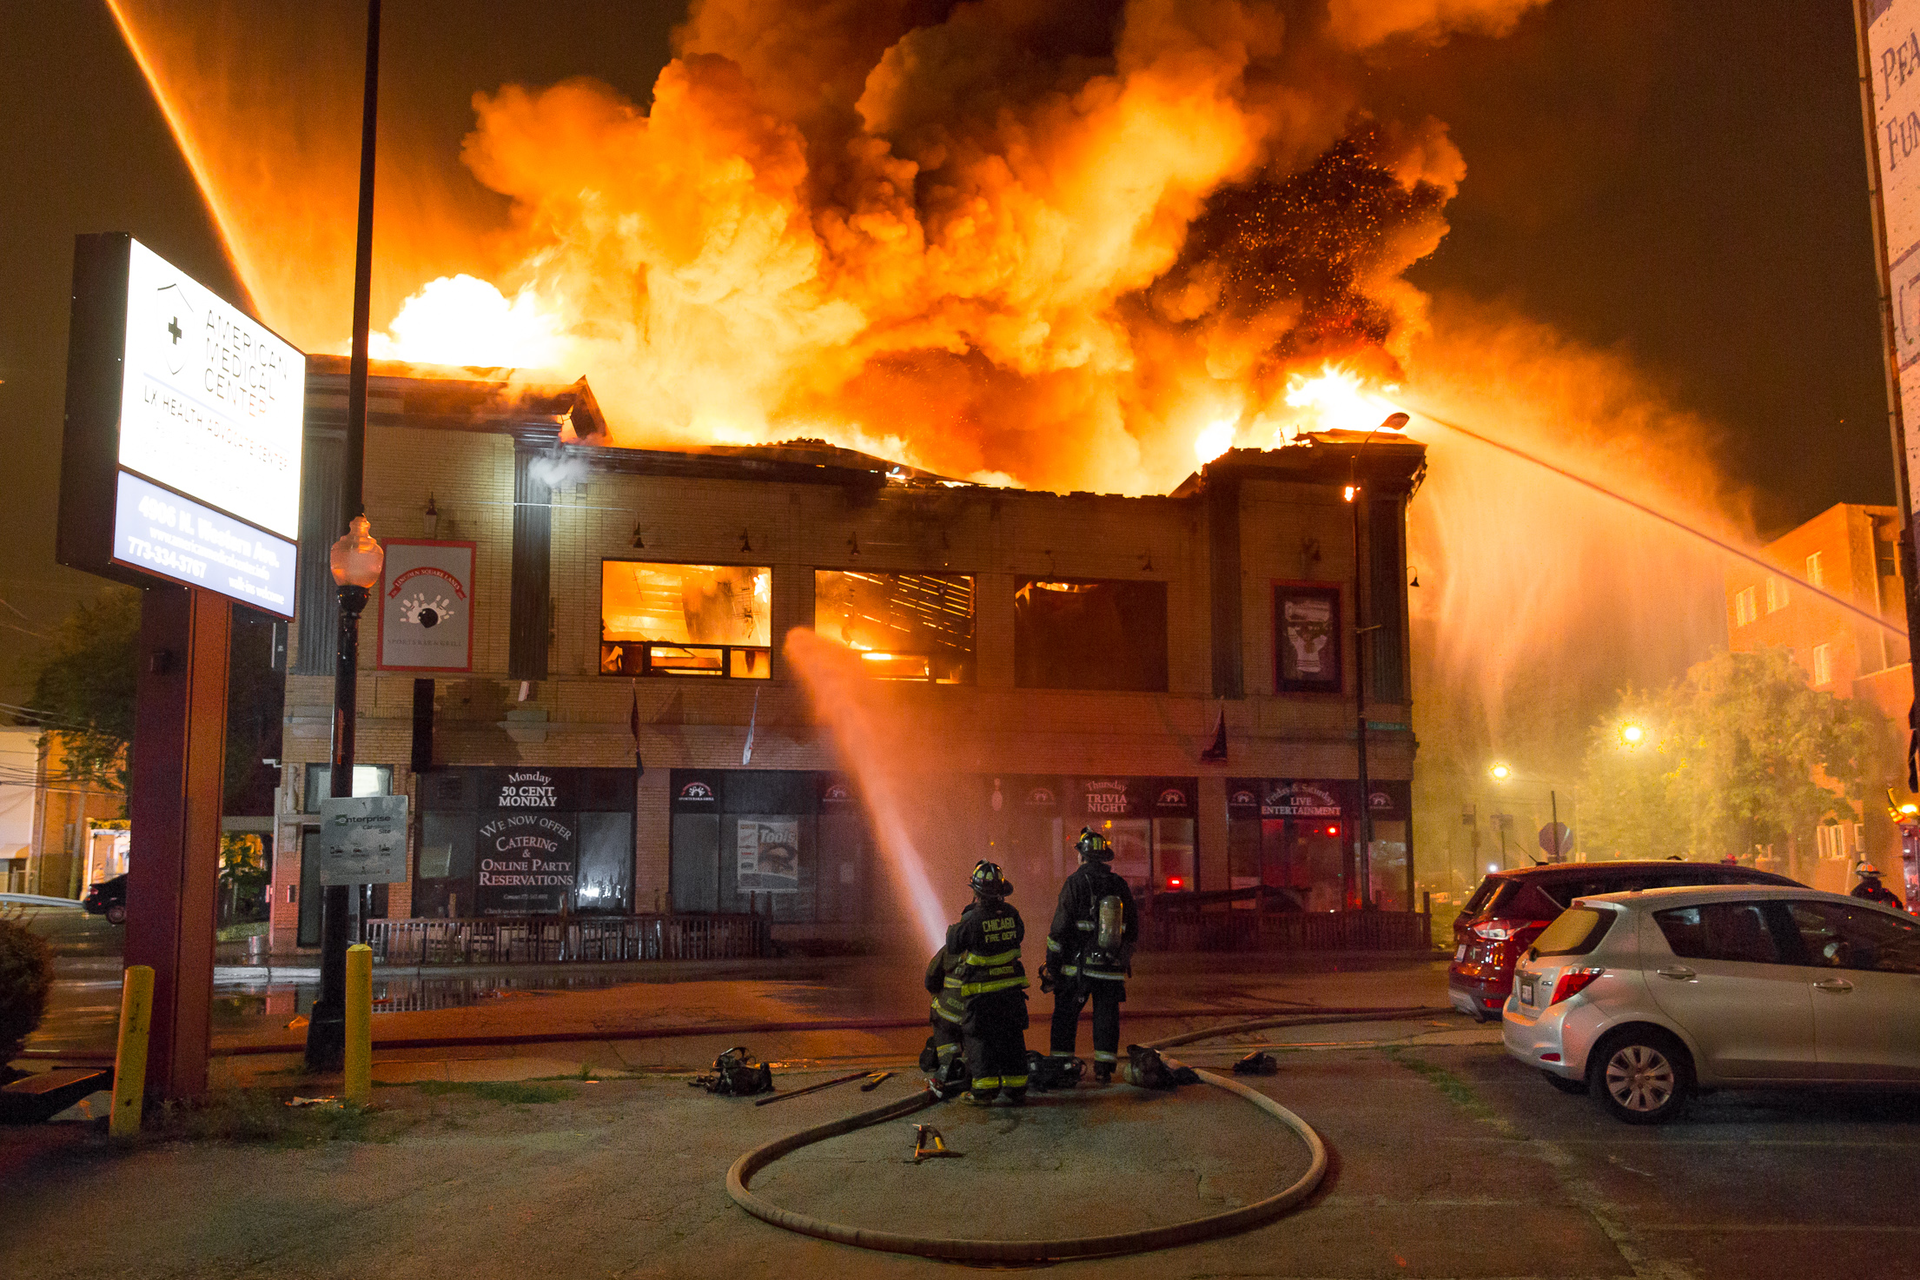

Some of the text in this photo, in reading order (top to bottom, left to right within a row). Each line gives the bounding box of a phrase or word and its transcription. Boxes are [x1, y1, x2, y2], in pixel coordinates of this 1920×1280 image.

[206, 309, 287, 380] AMERICAN
[206, 337, 275, 401] MEDICAL
[205, 367, 267, 418] CENTER
[144, 385, 157, 407] LX
[163, 394, 203, 430] HEALTH
[138, 495, 279, 568] 4906 N. Western Ave.
[128, 536, 207, 578] 773-334-3767
[508, 771, 551, 785] Monday
[501, 786, 555, 796] 50 CENT
[1085, 780, 1128, 793] Thursday
[498, 796, 557, 807] MONDAY
[1085, 793, 1127, 804] TRIVIA
[1290, 797, 1312, 806] LIVE
[1087, 803, 1126, 813] NIGHT
[1261, 805, 1341, 816] ENTERTAINMENT
[479, 815, 572, 841] WE NOW OFFER
[760, 829, 797, 843] Tools
[495, 836, 558, 852] CATERING
[522, 848, 531, 858] &
[481, 858, 572, 872] ONLINE PARTY
[478, 871, 574, 886] RESERVATIONS
[982, 917, 1015, 932] CHICAGO
[985, 930, 1017, 943] FIRE DEPT
